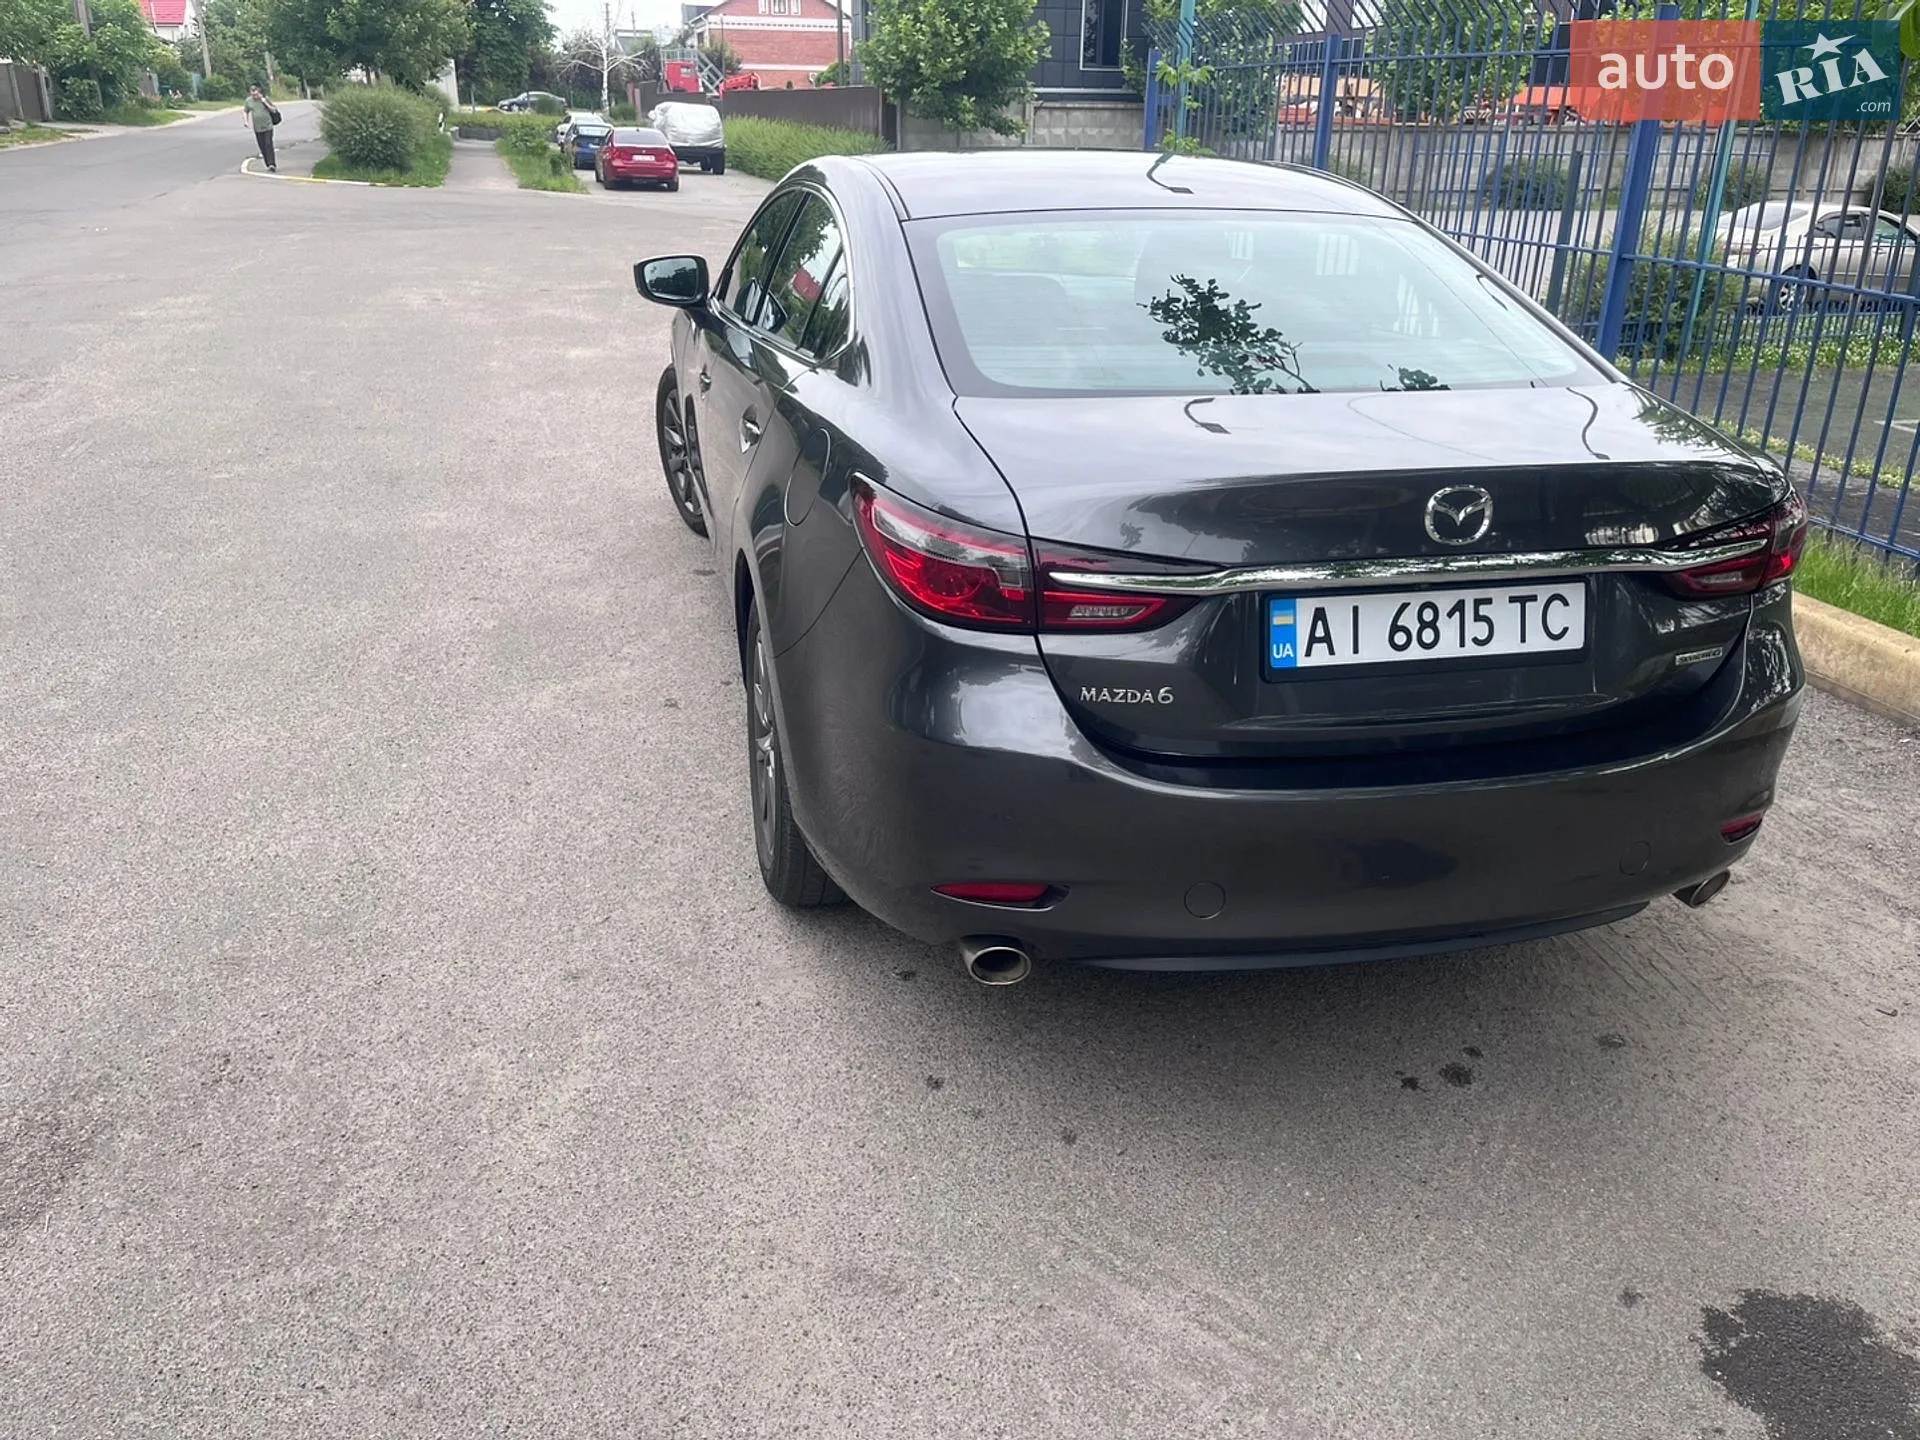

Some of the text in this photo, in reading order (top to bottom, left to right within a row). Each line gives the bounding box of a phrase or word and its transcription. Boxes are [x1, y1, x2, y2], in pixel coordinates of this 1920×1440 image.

[1304, 593, 1571, 657] AI 6815 TC
[1272, 643, 1294, 659] UA
[1080, 686, 1175, 704] MAZDA6
